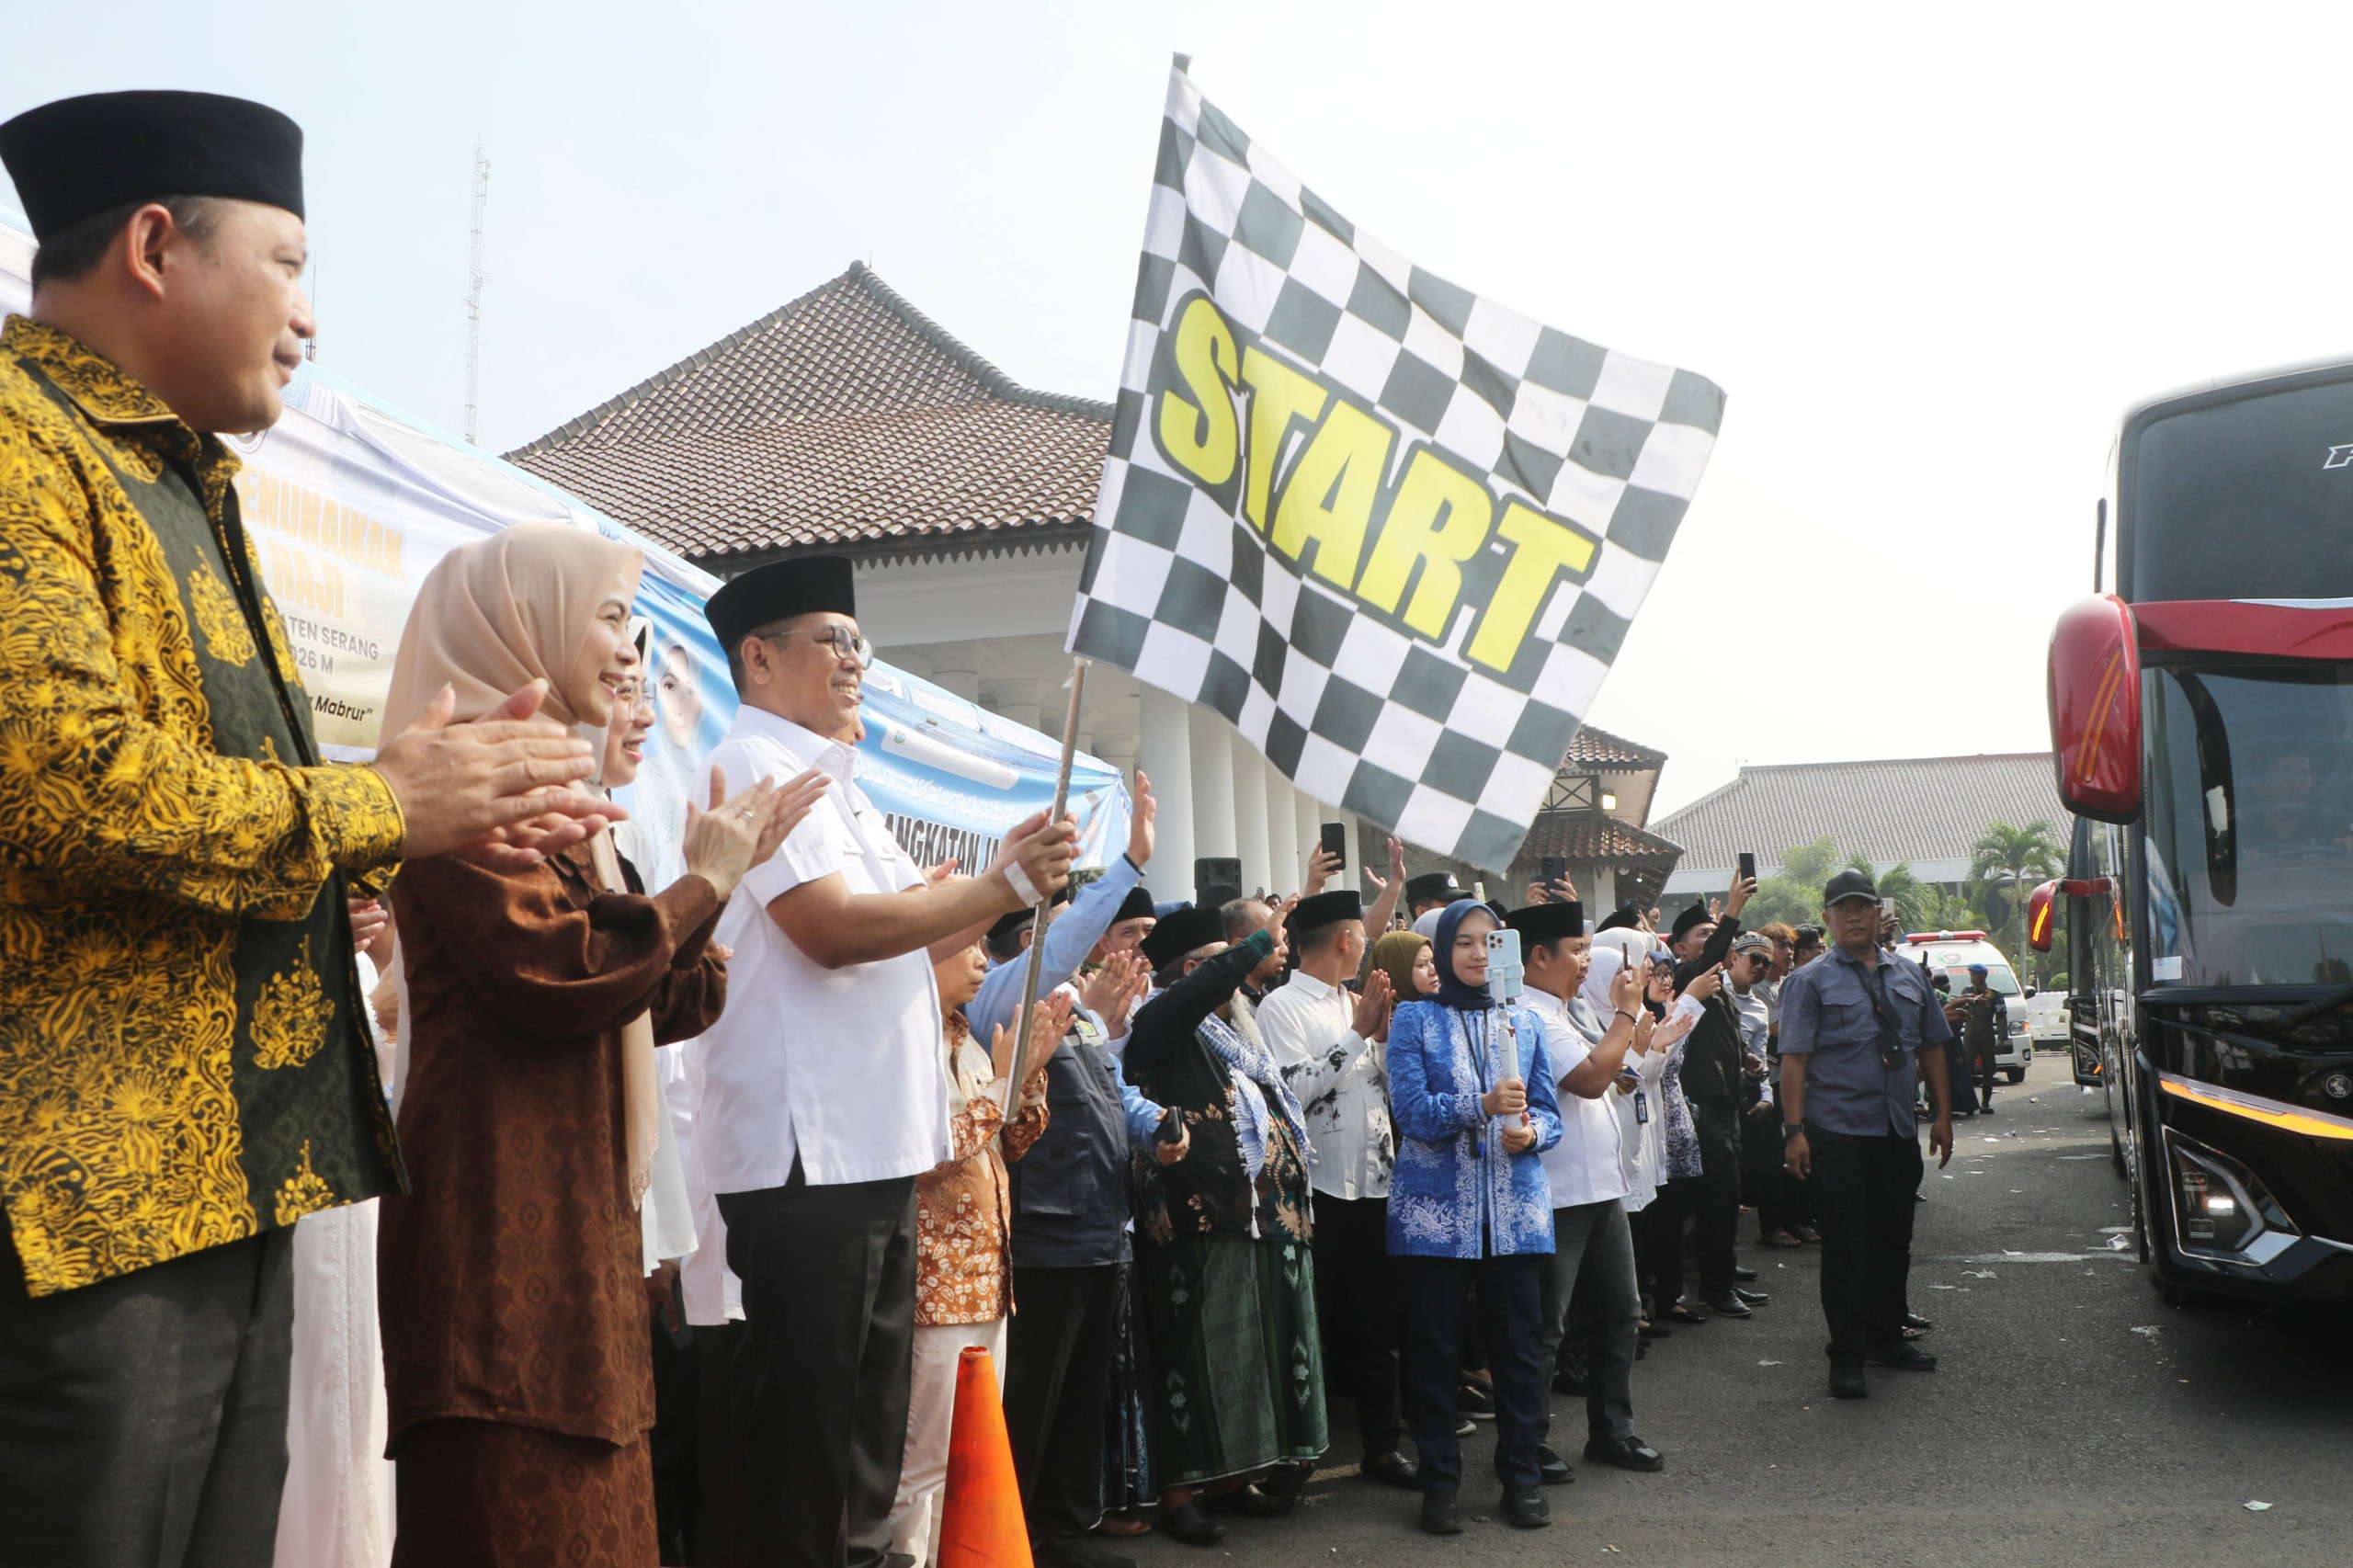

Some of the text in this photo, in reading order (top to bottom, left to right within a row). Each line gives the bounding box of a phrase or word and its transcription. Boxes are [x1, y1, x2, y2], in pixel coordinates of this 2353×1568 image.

[232, 461, 407, 583] ENUNAIKAN
[1158, 296, 1597, 675] START
[267, 539, 344, 619] HAJI
[280, 614, 379, 660] TEN SERANG
[321, 654, 334, 675] M
